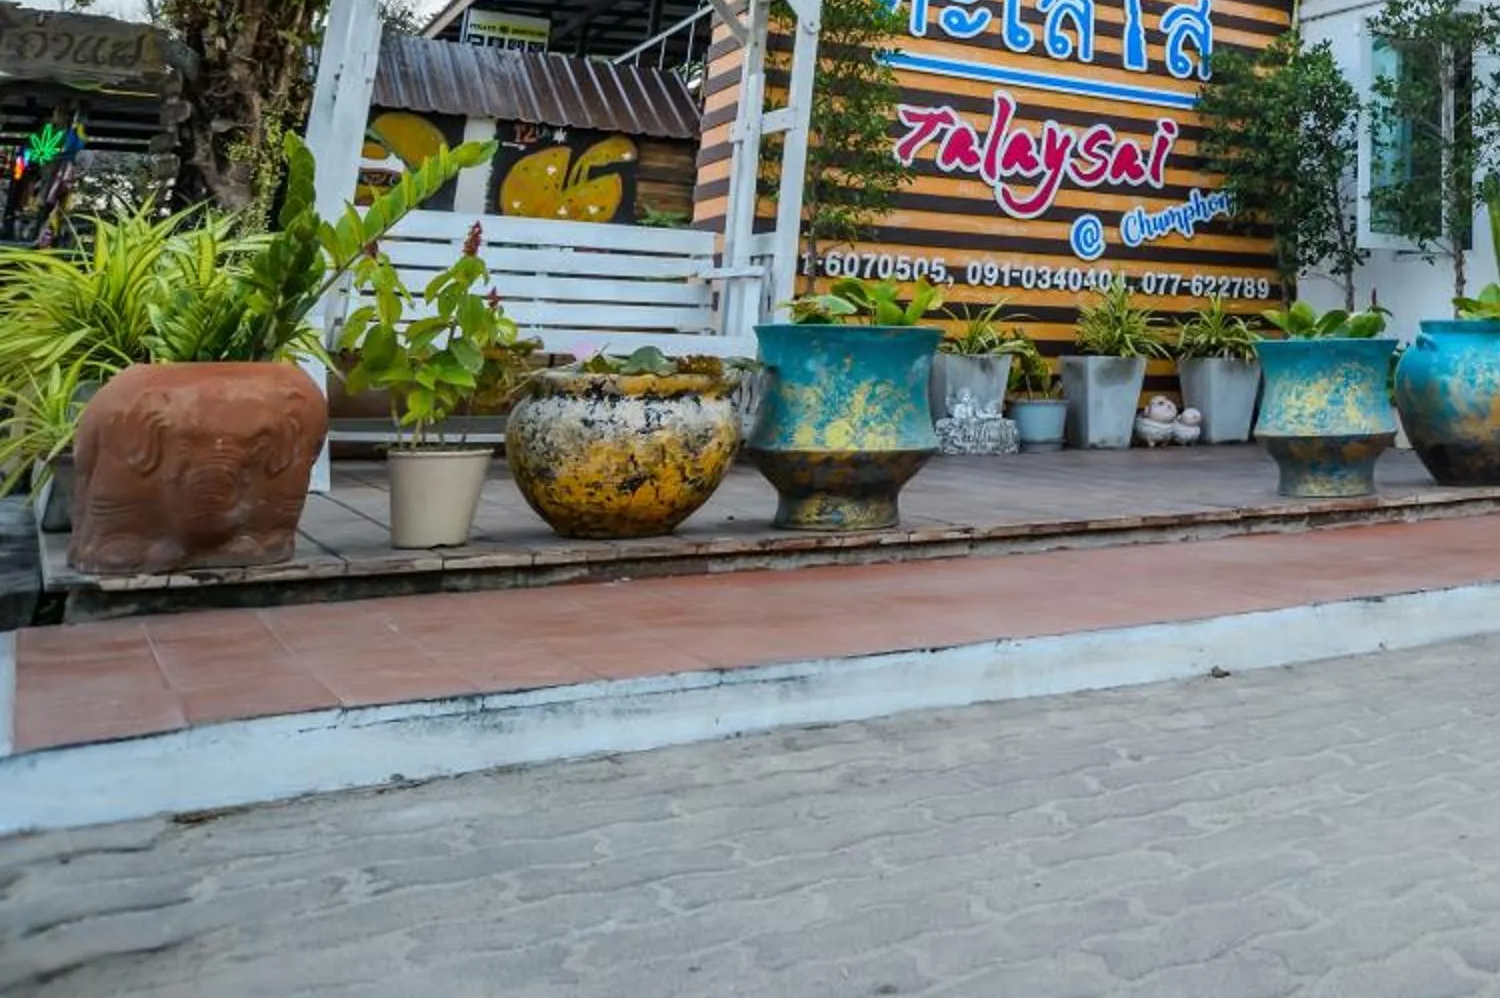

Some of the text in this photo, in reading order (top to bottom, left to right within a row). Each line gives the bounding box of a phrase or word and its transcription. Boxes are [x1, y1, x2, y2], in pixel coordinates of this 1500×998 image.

[895, 90, 1178, 218] Talaysai
[1120, 188, 1235, 247] Chumphon
[1142, 271, 1270, 300] 077-622789
